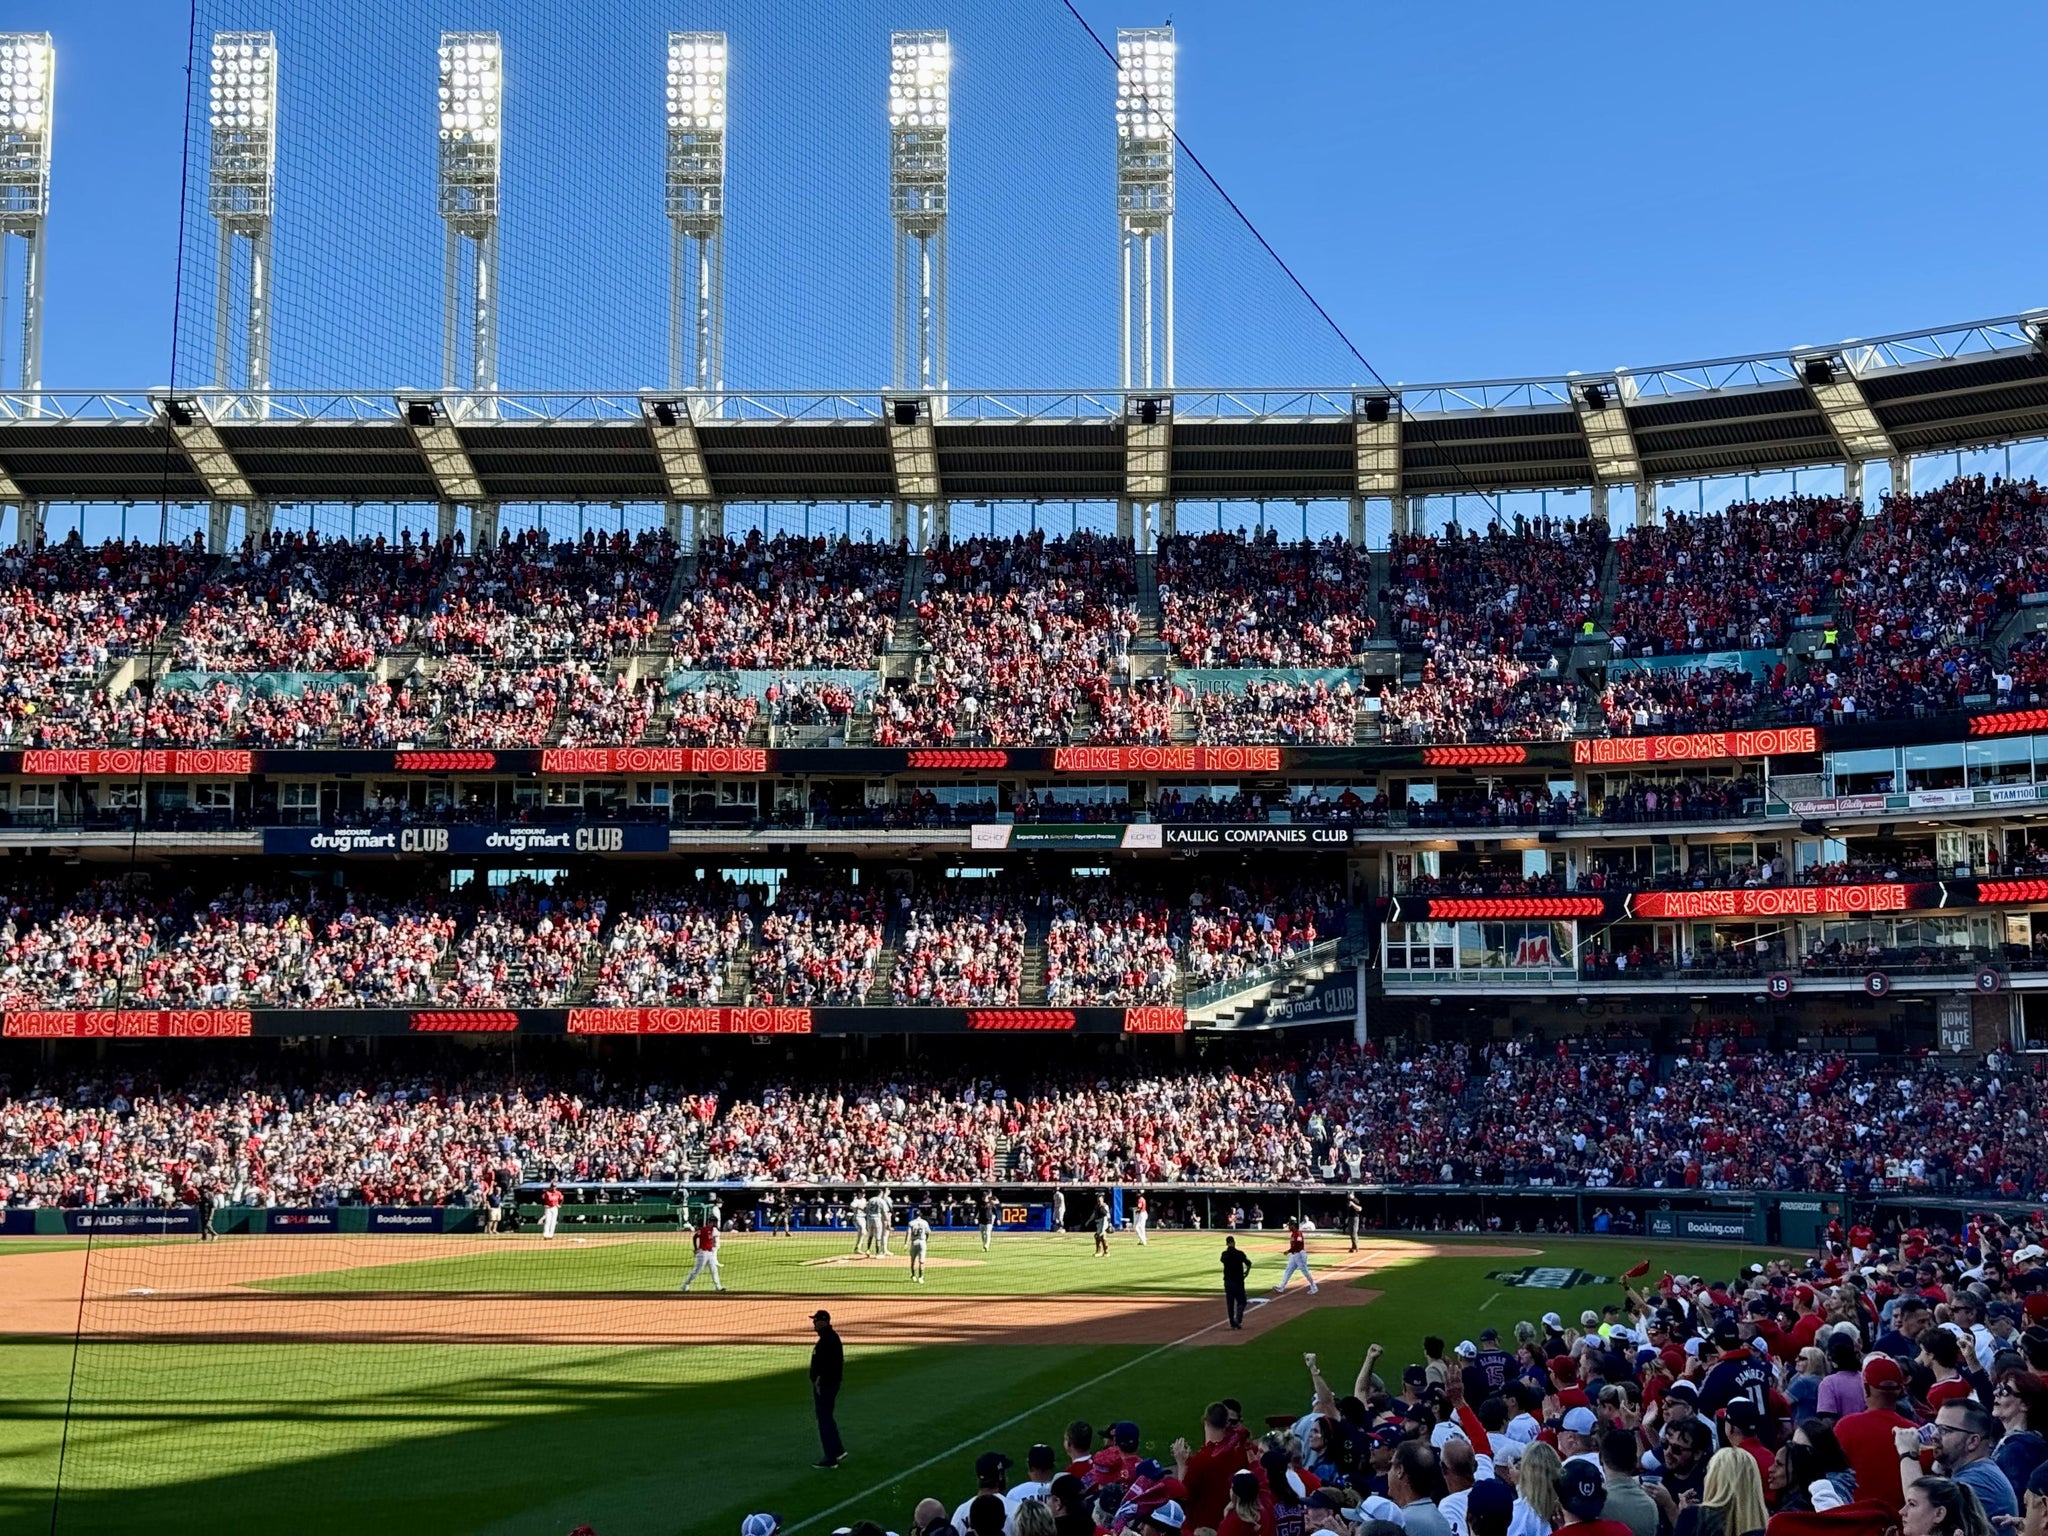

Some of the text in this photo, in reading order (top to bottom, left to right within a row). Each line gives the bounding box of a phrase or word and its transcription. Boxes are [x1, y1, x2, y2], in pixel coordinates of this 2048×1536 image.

[1575, 728, 1815, 763] MAKE SOME NOISE
[22, 751, 251, 773] MAKE SOME NOISE
[542, 750, 767, 771] MAKE SOME NOISE
[1054, 748, 1279, 770] MAKE SOME NOISE
[1793, 802, 1816, 812] Bally
[1840, 799, 1883, 810] Bally SPORTS
[311, 833, 395, 851] drug mart
[401, 829, 448, 852] CLUB
[486, 832, 570, 851] drug mart
[576, 828, 623, 851] CLUB
[1166, 830, 1348, 842] KAULIG COMPANIES CLUB
[1664, 885, 1906, 916] MAKE SOME NOISE
[1772, 979, 1787, 991] 19
[1872, 979, 1881, 990] 5
[1983, 976, 1992, 987] 3
[1267, 996, 1321, 1019] drug mart
[1324, 987, 1355, 1014] CLUB
[3, 1012, 252, 1037] MAKE SOME NOISE
[568, 1009, 811, 1033] MAKE SOME NOISE
[1125, 1008, 1184, 1032] MAK
[1941, 1011, 1969, 1028] HOME
[1942, 1029, 1970, 1046] PLATE
[93, 1216, 123, 1225] ALDS
[146, 1216, 189, 1224] Booking.com
[377, 1215, 432, 1224] Booking.com
[1687, 1222, 1744, 1235] Booking.com
[1486, 1366, 1505, 1386] 15
